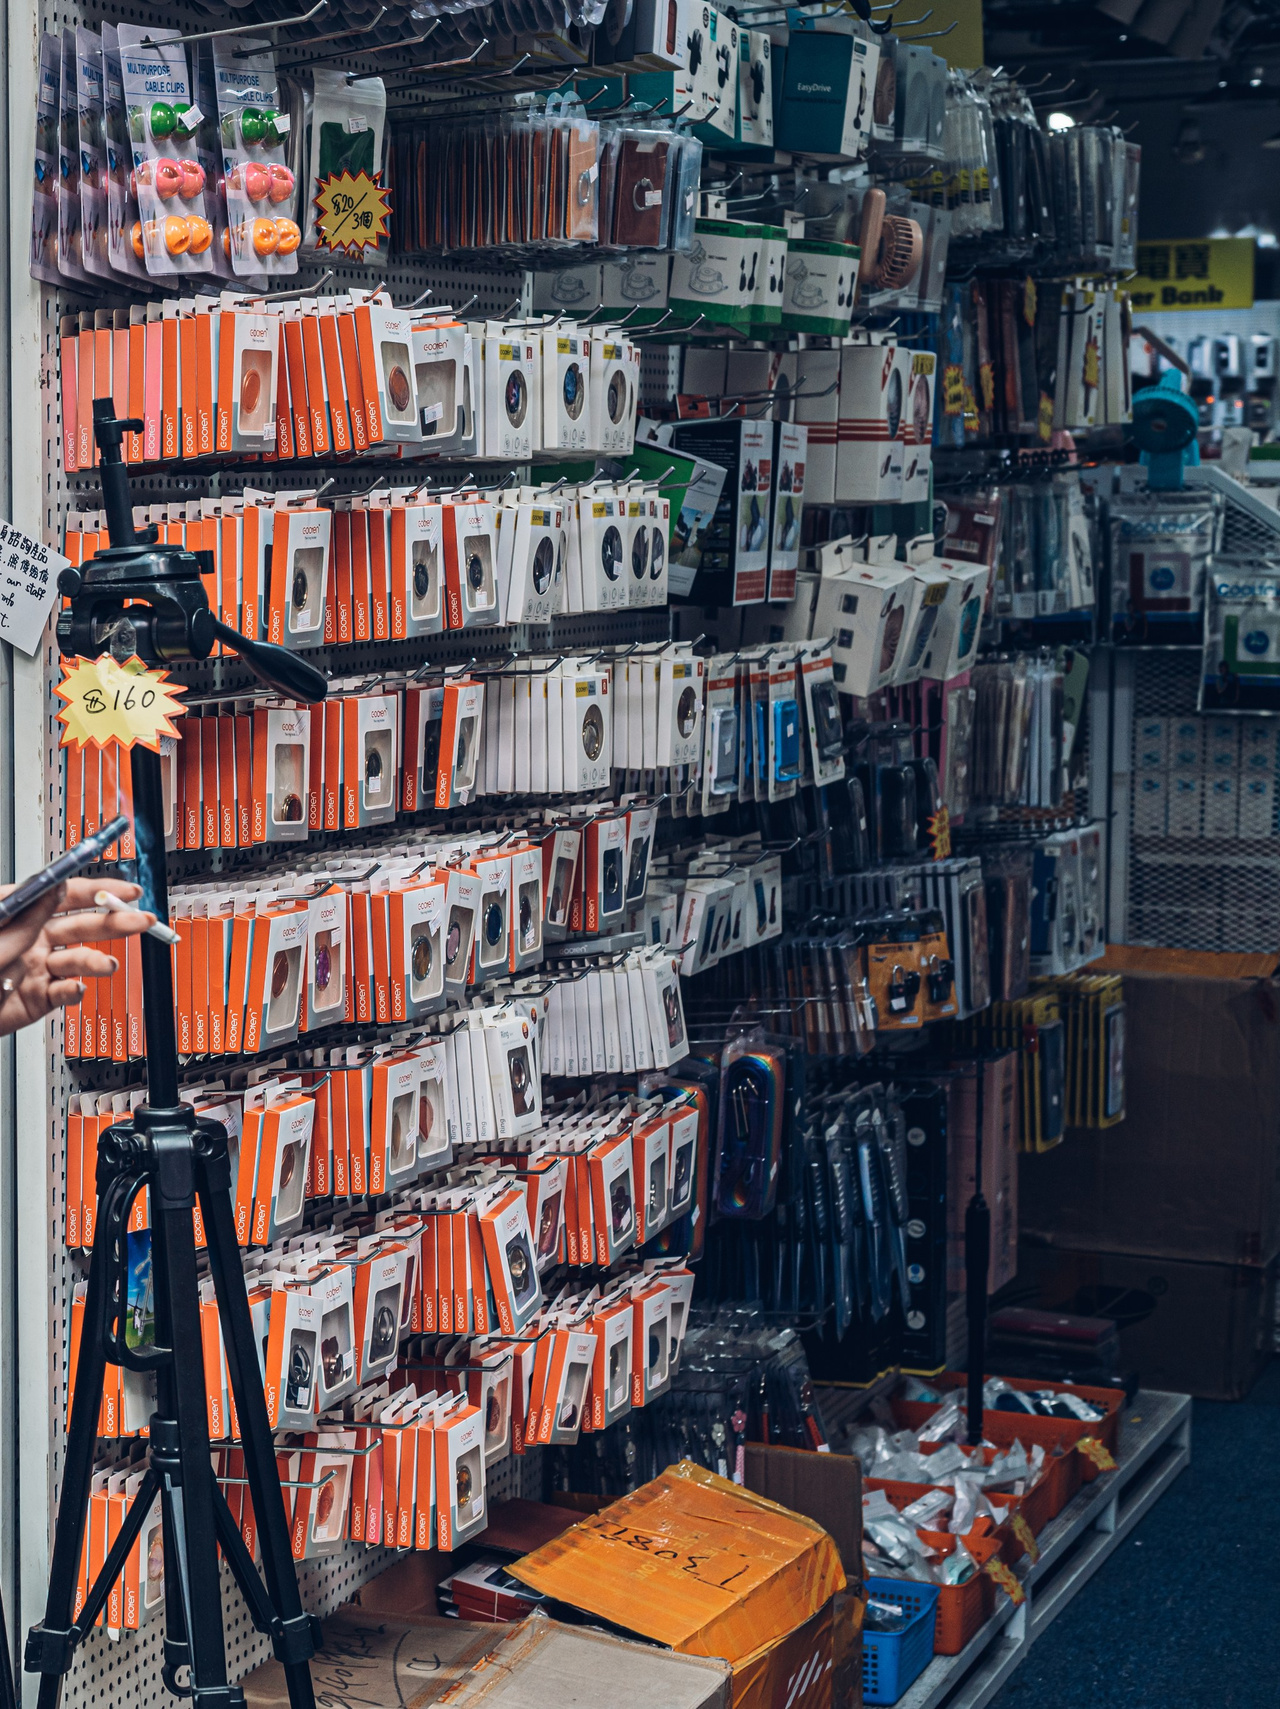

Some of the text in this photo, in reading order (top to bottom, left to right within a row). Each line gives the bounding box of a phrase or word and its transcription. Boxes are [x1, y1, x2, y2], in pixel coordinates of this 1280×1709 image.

[127, 62, 171, 76] MULTIPURPOSE
[219, 71, 260, 86] MULTIPURPOSE
[145, 81, 185, 93] CABLE CLIPS
[797, 82, 832, 93] EasyDrive
[256, 92, 274, 103] CLIPS
[1161, 285, 1224, 305] Bank
[6, 577, 22, 587] our
[25, 583, 47, 601] staff
[82, 685, 156, 714] $160
